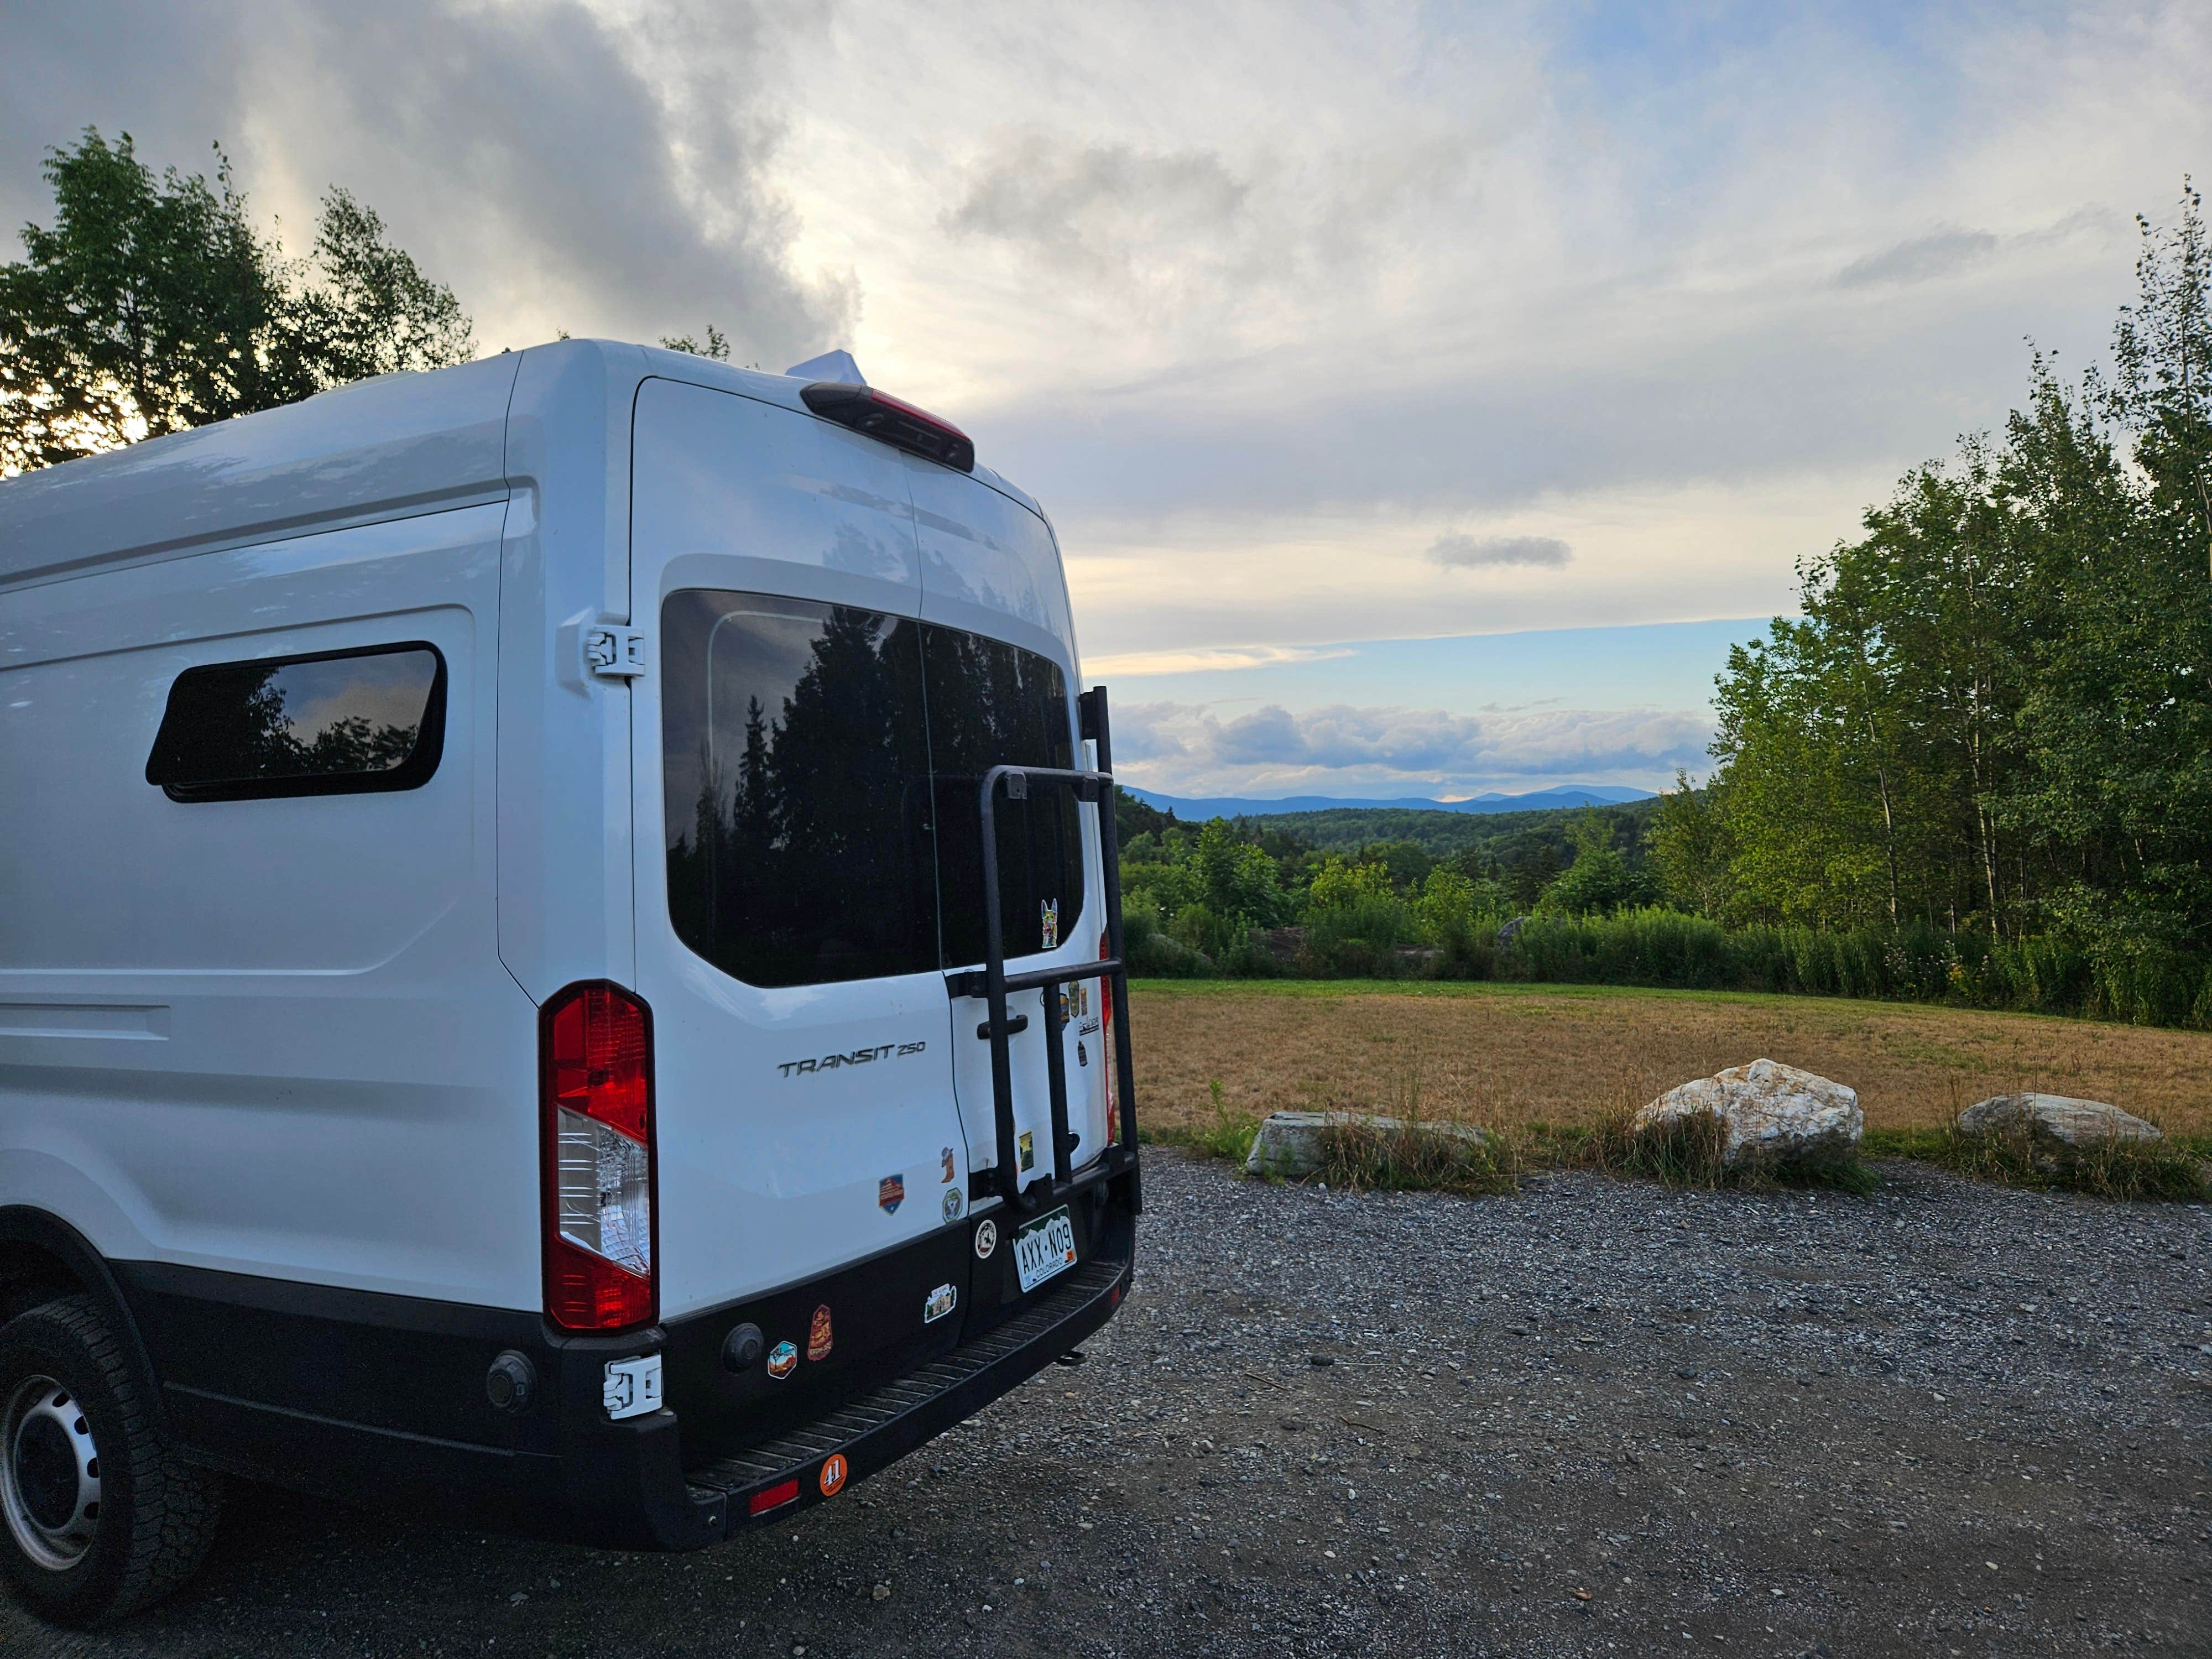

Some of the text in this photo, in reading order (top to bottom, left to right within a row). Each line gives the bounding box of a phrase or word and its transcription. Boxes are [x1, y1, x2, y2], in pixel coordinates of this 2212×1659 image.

[777, 1041, 926, 1078] TRANSIT 250
[1036, 1258, 1063, 1278] COLORADO
[823, 1459, 841, 1486] 41
